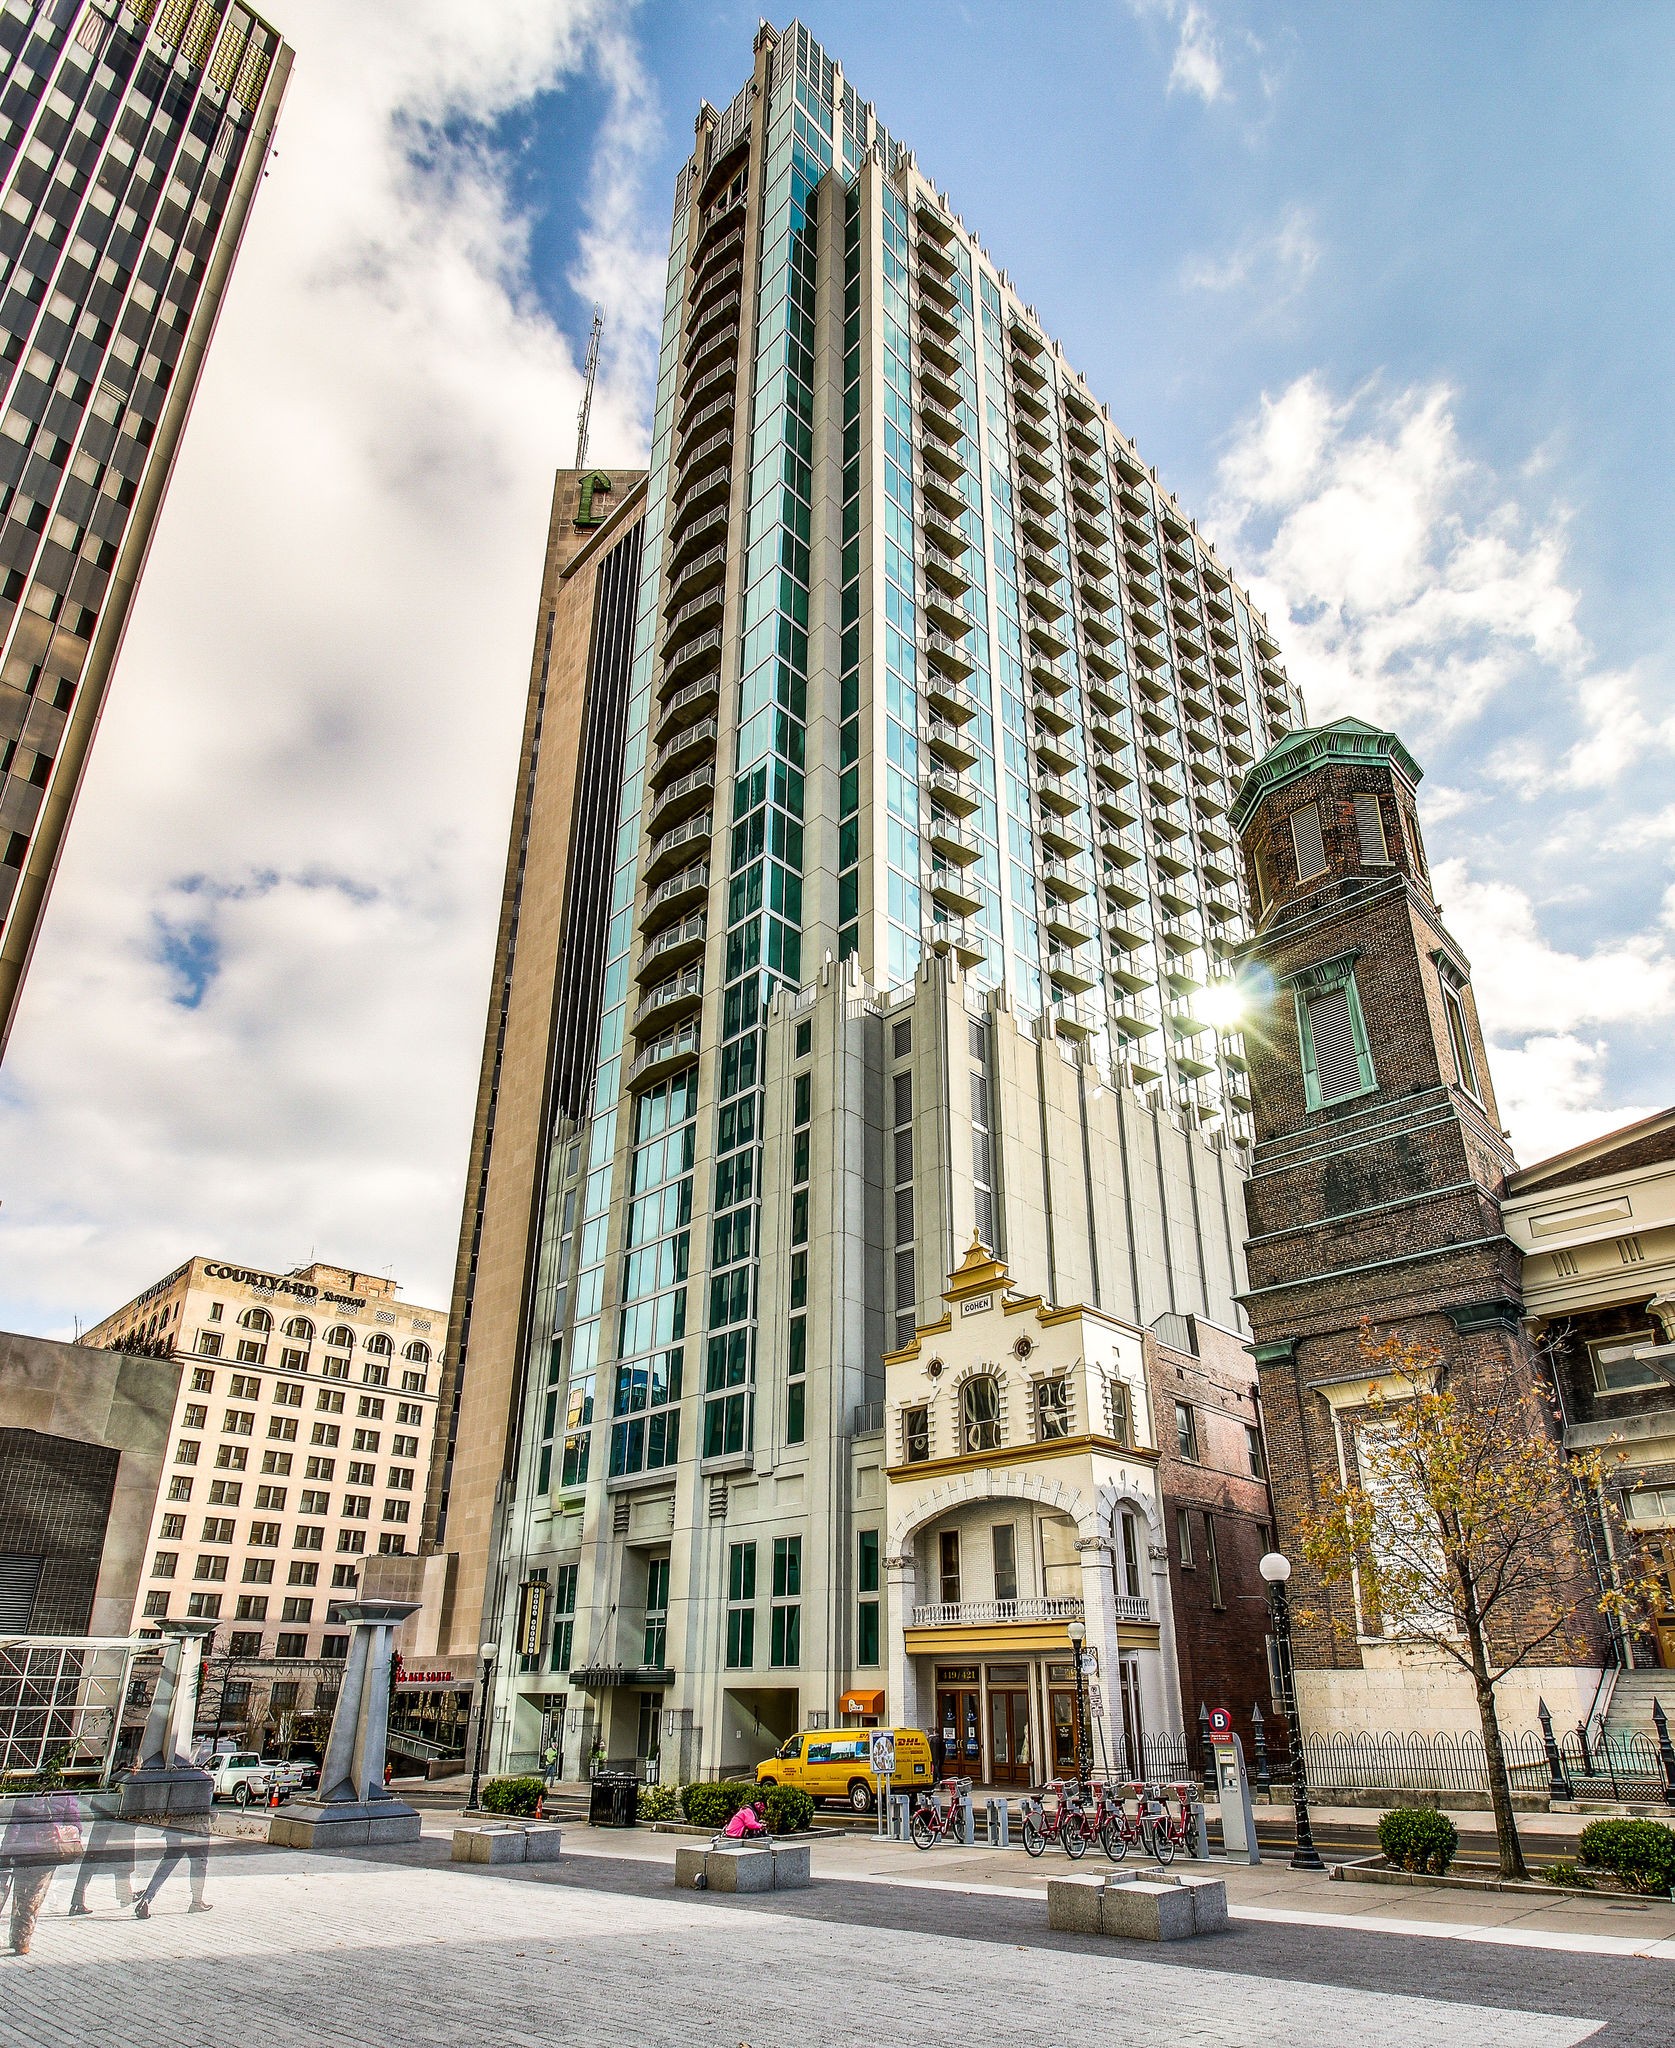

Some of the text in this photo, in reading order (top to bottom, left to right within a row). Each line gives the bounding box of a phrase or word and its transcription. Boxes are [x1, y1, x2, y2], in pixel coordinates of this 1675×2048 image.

[204, 1263, 319, 1298] COURTYARD
[965, 1300, 989, 1312] COHEN
[1214, 1713, 1225, 1728] B
[896, 1737, 921, 1747] DHL
